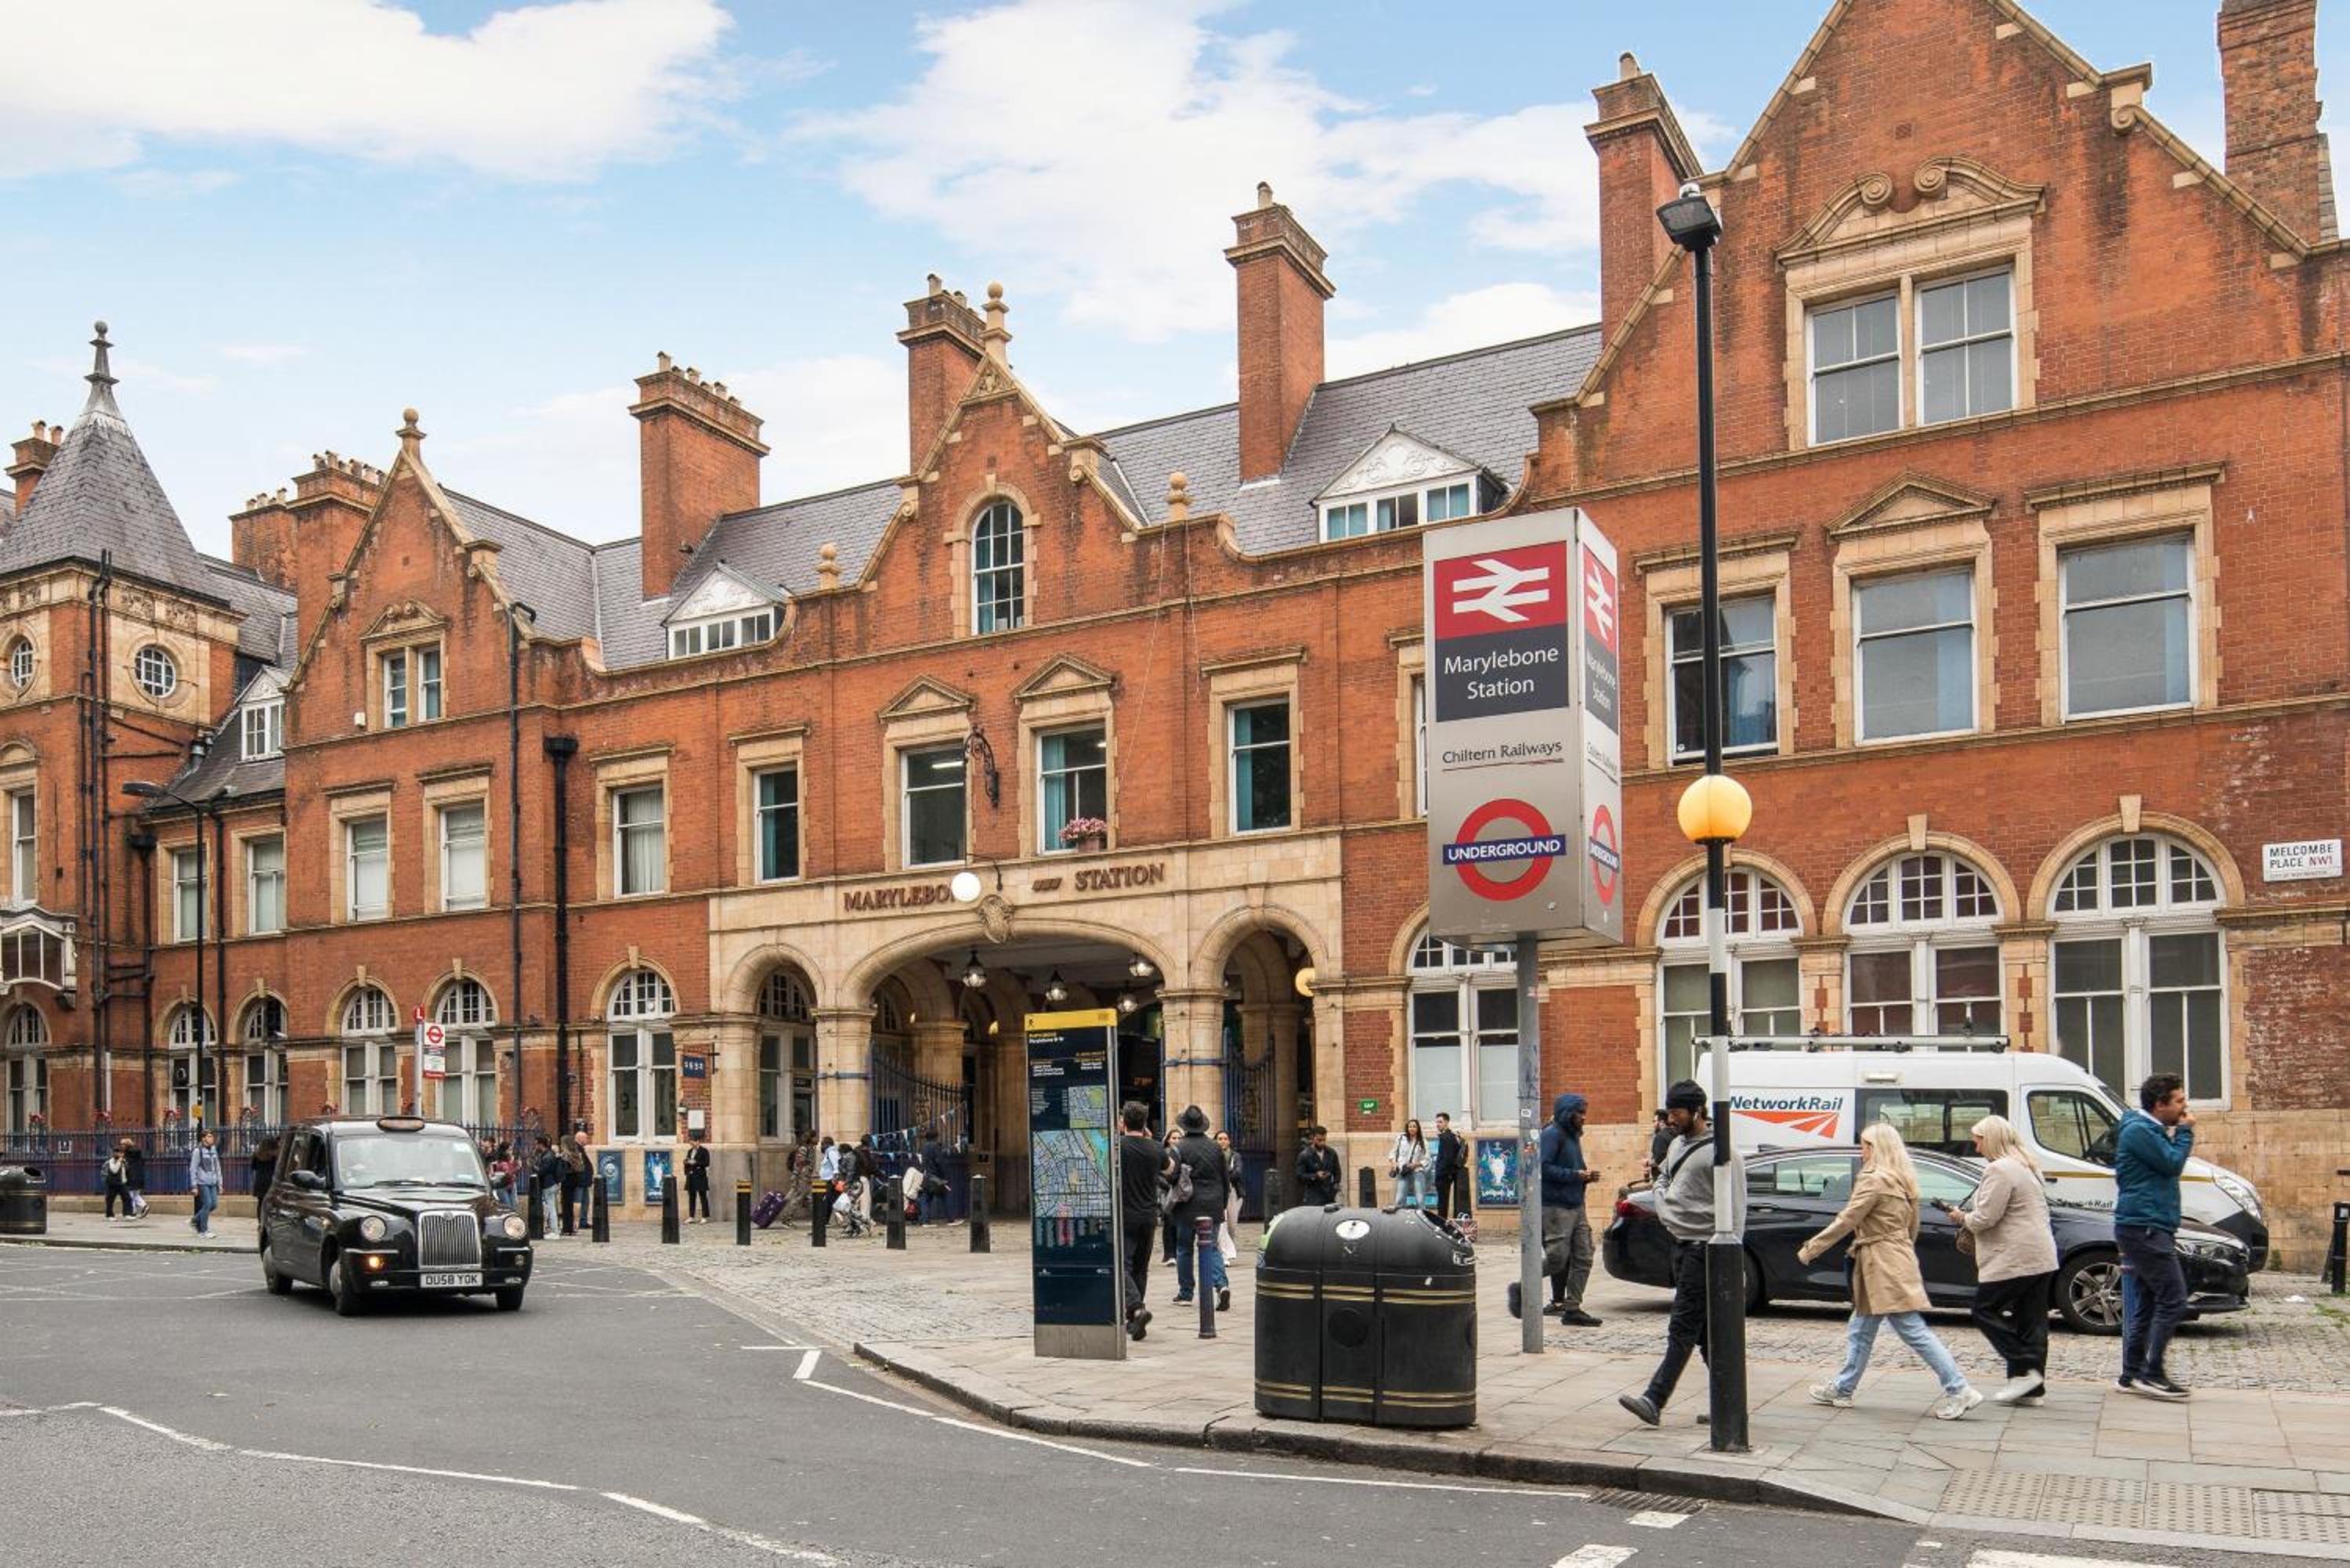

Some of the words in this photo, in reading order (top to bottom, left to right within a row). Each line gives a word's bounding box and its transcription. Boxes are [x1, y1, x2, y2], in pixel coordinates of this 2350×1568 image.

[1444, 647, 1559, 675] Marylebone
[1467, 677, 1535, 699] Station
[1442, 750, 1496, 764] Chiltern
[1500, 742, 1563, 757] Railways
[1448, 839, 1560, 861] UNDERGROUND
[2269, 844, 2333, 857] MELCOMBE
[2269, 857, 2303, 869] PLACE
[2308, 855, 2333, 866] NW1
[844, 882, 955, 912] MARYLEBO
[1076, 862, 1165, 892] STATION
[457, 1274, 477, 1284] YOK
